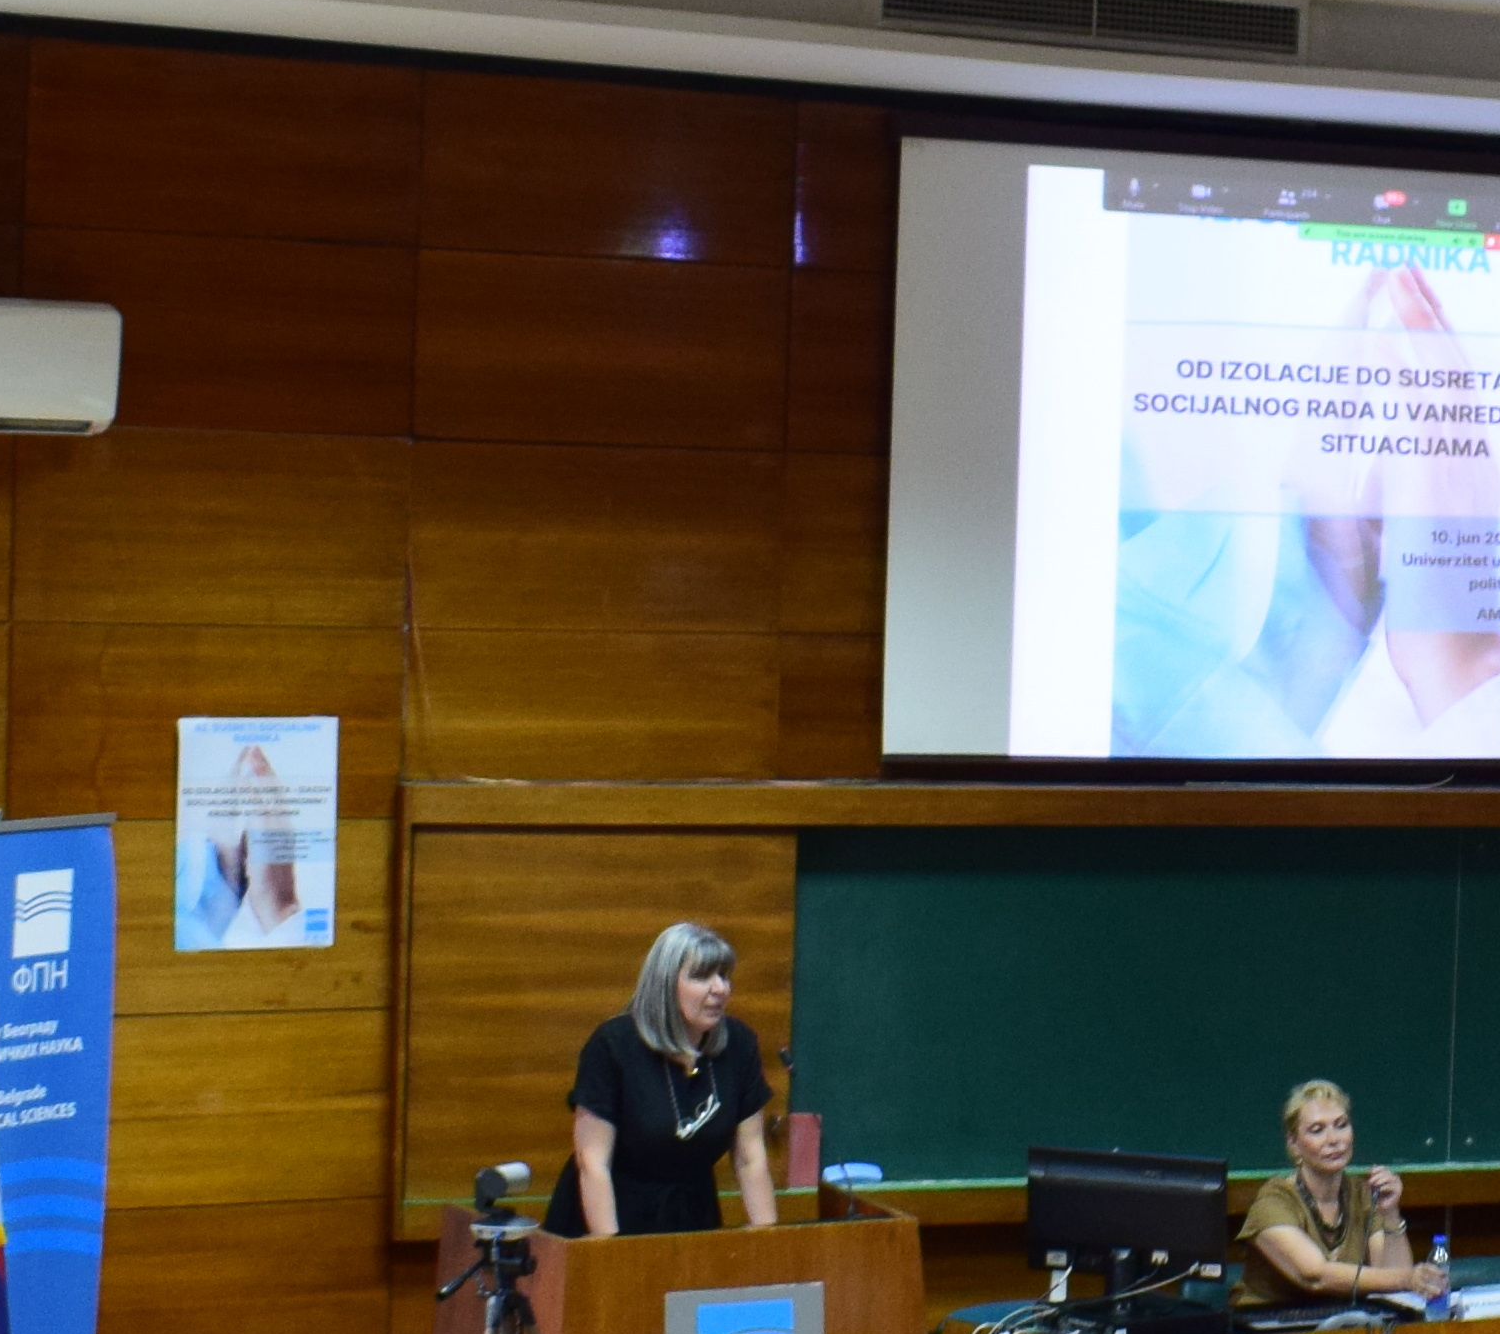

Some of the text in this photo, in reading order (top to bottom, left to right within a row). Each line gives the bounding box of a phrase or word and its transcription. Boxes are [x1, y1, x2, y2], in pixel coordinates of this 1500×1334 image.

[1331, 240, 1491, 273] RADNIKA
[1176, 359, 1213, 379] OD
[1220, 360, 1349, 385] IZOLACIJE
[1356, 367, 1391, 387] DO
[1133, 392, 1300, 417] SOCIJALNOG
[1306, 399, 1375, 420] RADA
[1382, 402, 1399, 421] U
[1321, 433, 1490, 458] SITUACIJAMA
[1431, 530, 1452, 545] 10.
[1456, 532, 1481, 547] jun
[1402, 552, 1488, 567] Univerzitet
[1492, 555, 1500, 567] u
[12, 958, 68, 993] ФПН
[39, 1035, 84, 1055] НАУКА
[20, 1102, 78, 1123] SCIENCES
